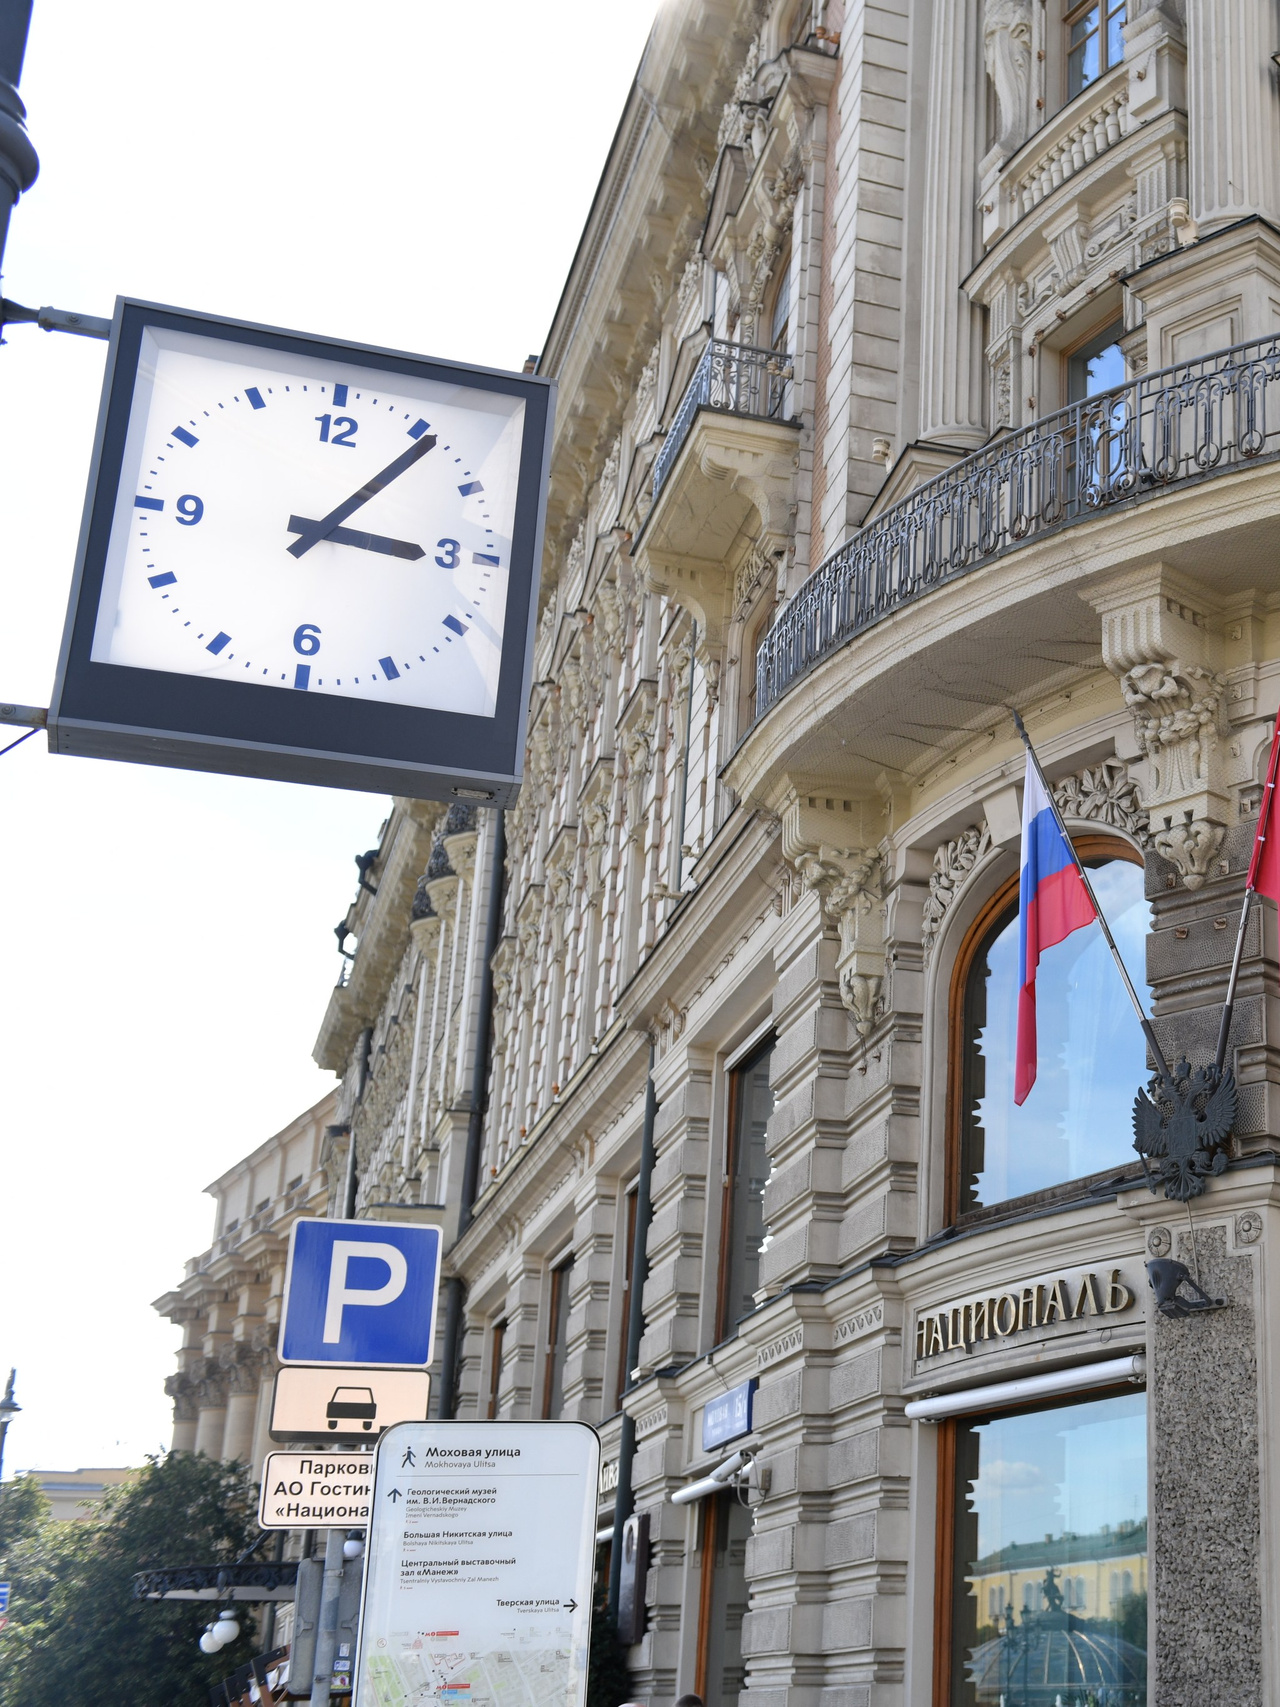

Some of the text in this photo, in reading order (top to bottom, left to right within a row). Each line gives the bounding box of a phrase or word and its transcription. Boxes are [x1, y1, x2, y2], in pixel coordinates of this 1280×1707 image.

[314, 413, 360, 449] 12
[174, 493, 205, 527] 9
[433, 538, 461, 570] 3
[292, 623, 322, 657] 6
[321, 1239, 409, 1345] P
[914, 1268, 1136, 1361] НАЦИОНАЛЬ
[425, 1447, 521, 1459] Моховая улица
[299, 1460, 374, 1478] Парков
[424, 1460, 496, 1469] Mokhovaya Ulitsa
[273, 1481, 303, 1496] АО
[407, 1487, 497, 1497] Геологический музей
[405, 1505, 448, 1513] Geologicheskiy
[423, 1511, 459, 1519] Vernadskogo
[403, 1530, 513, 1539] Большая Никитская улица
[401, 1557, 516, 1568] Центральный выставочный
[416, 1568, 459, 1577] «Манеж»
[496, 1598, 560, 1608] Тверская улица
